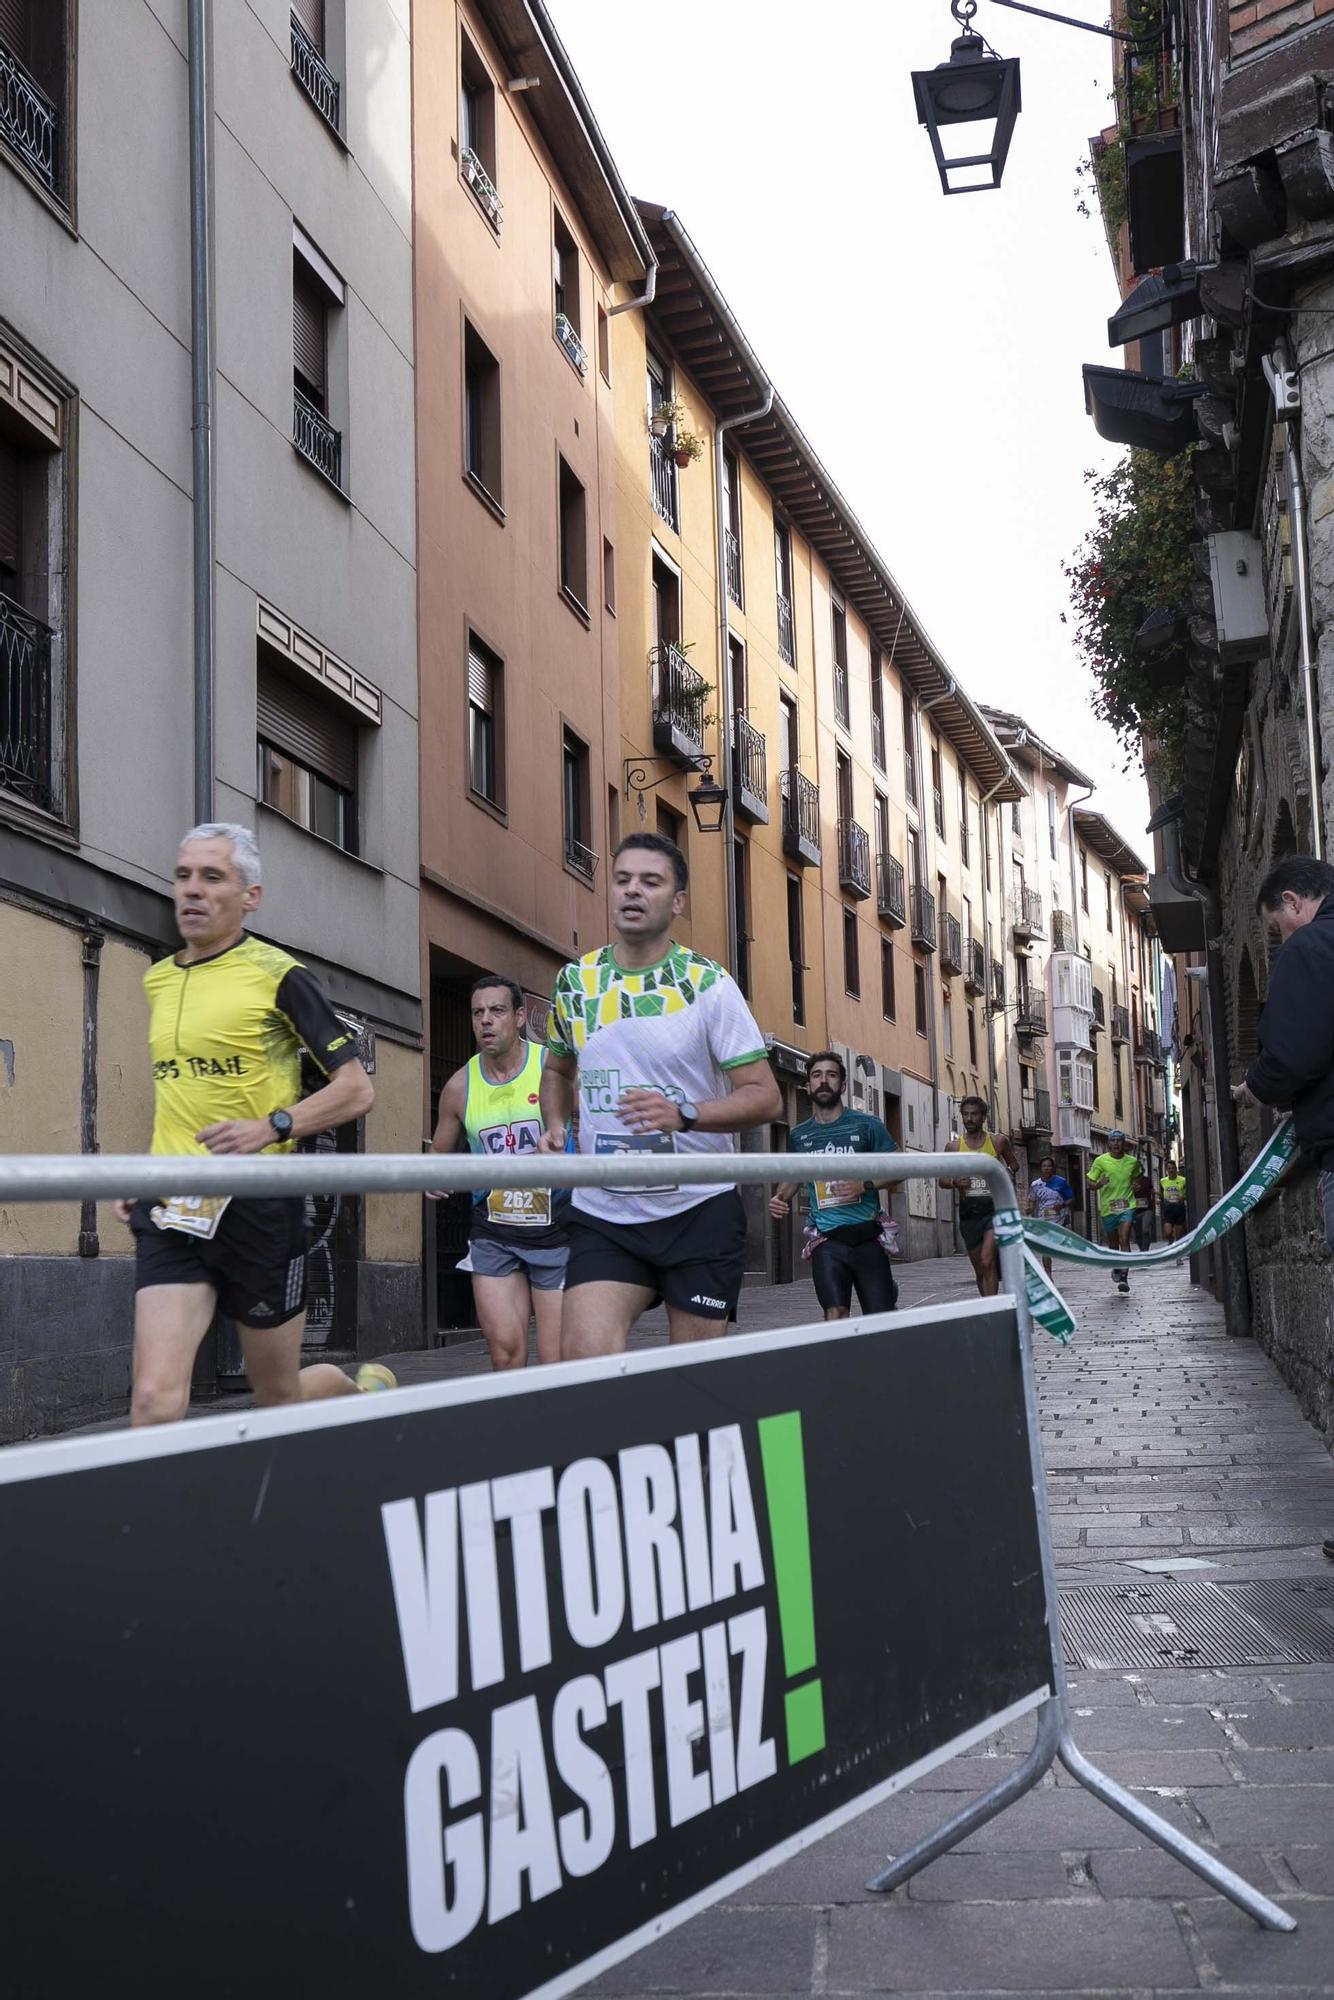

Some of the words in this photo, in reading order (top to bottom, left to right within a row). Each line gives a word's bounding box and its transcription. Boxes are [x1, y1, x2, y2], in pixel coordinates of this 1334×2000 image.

[503, 1190, 534, 1209] 262
[381, 1423, 765, 1713] VITORIA
[404, 1606, 777, 1953] GASTEIZ
